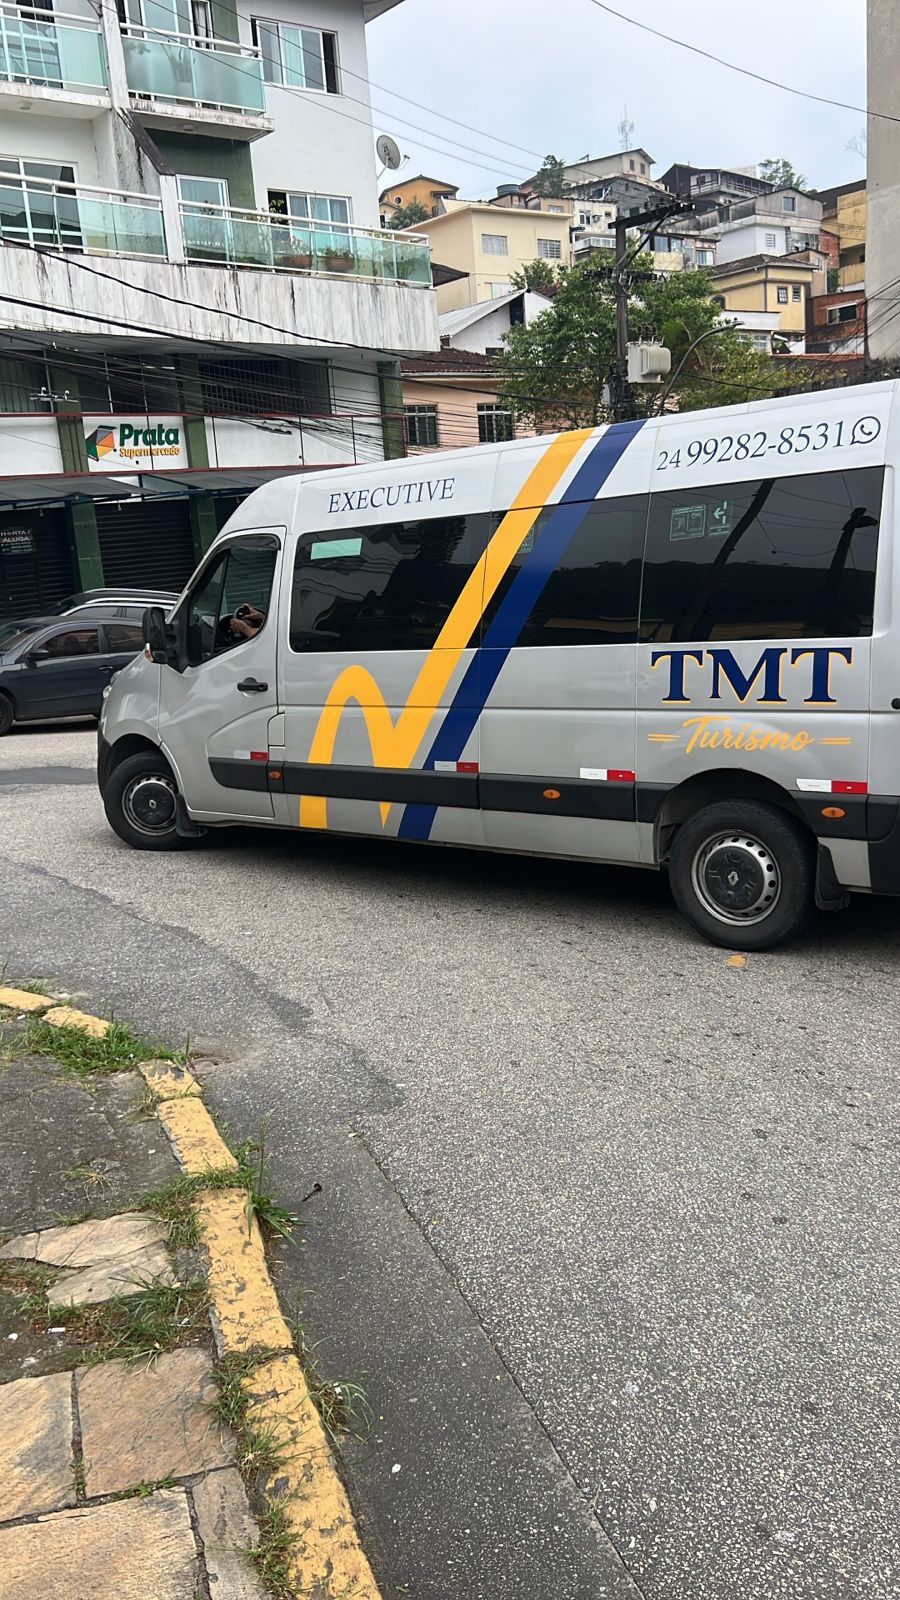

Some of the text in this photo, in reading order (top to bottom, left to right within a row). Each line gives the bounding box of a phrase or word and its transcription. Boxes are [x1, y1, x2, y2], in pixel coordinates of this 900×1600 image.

[119, 423, 179, 447] Prata
[119, 446, 181, 459] Supermercado
[656, 420, 844, 471] 24 99282-8531
[327, 477, 456, 514] EXECUTIVE
[651, 647, 853, 704] TMT
[682, 715, 815, 755] Turismo
